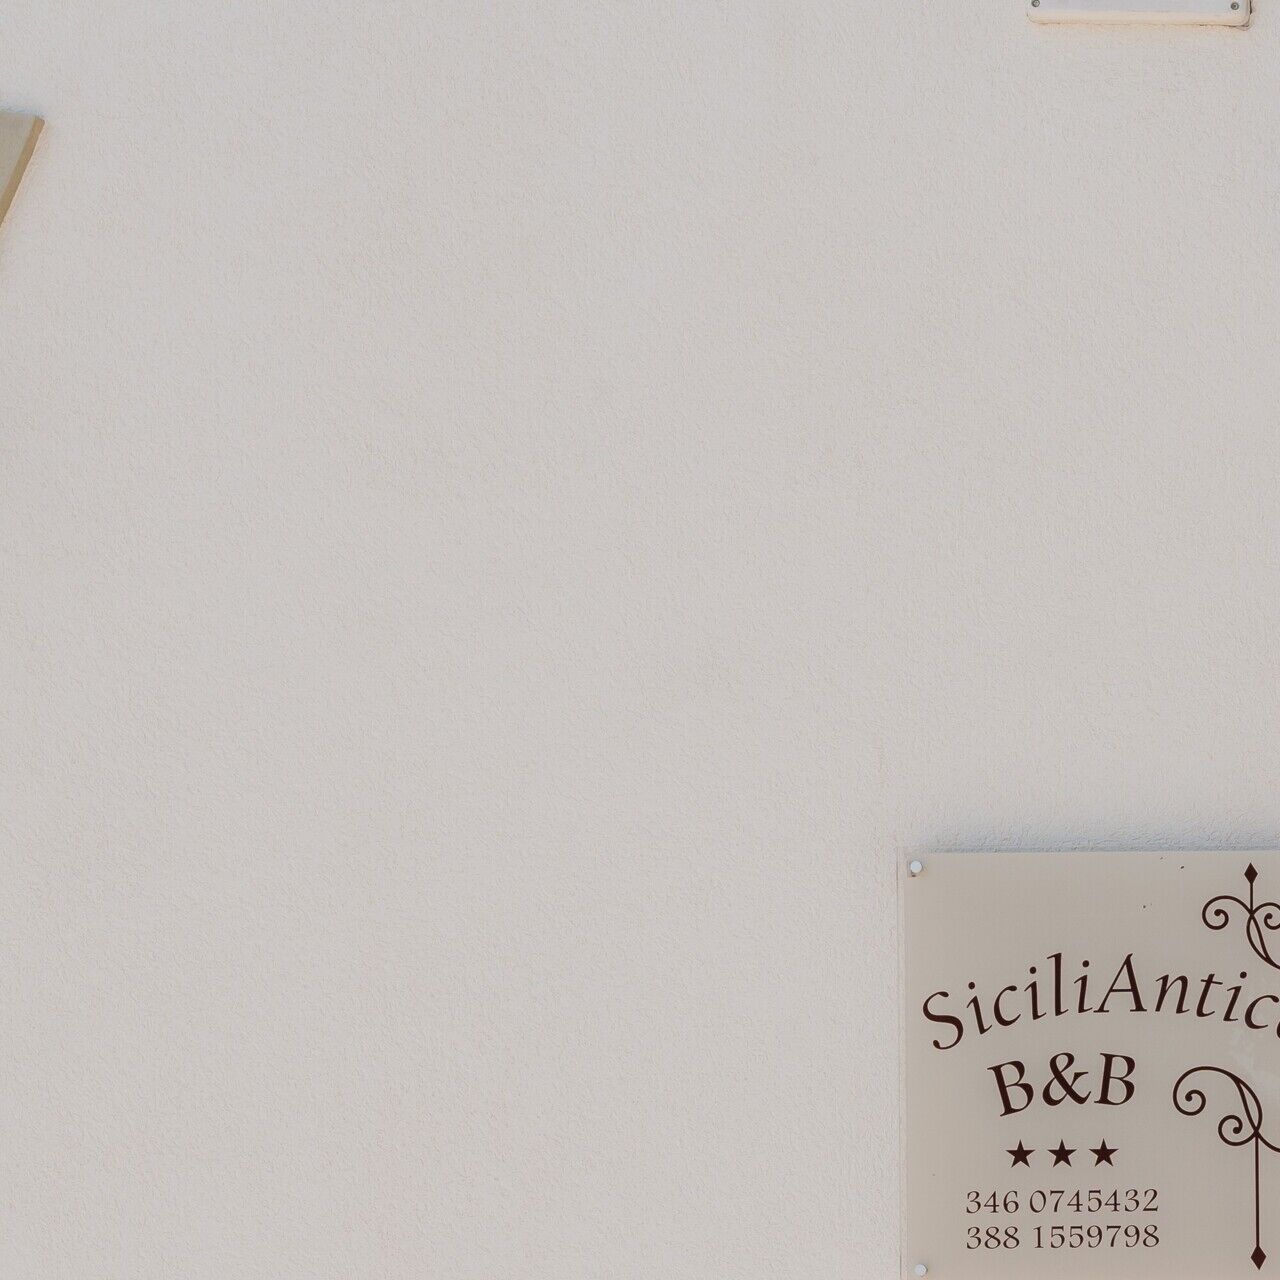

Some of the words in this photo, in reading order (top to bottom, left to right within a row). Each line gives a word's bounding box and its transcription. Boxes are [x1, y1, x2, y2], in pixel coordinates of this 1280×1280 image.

[987, 1052, 1136, 1117] B&B
[966, 1190, 1020, 1214] 346
[1029, 1188, 1159, 1214] 0745432
[966, 1226, 1020, 1250] 388
[1033, 1224, 1160, 1250] 1559798
